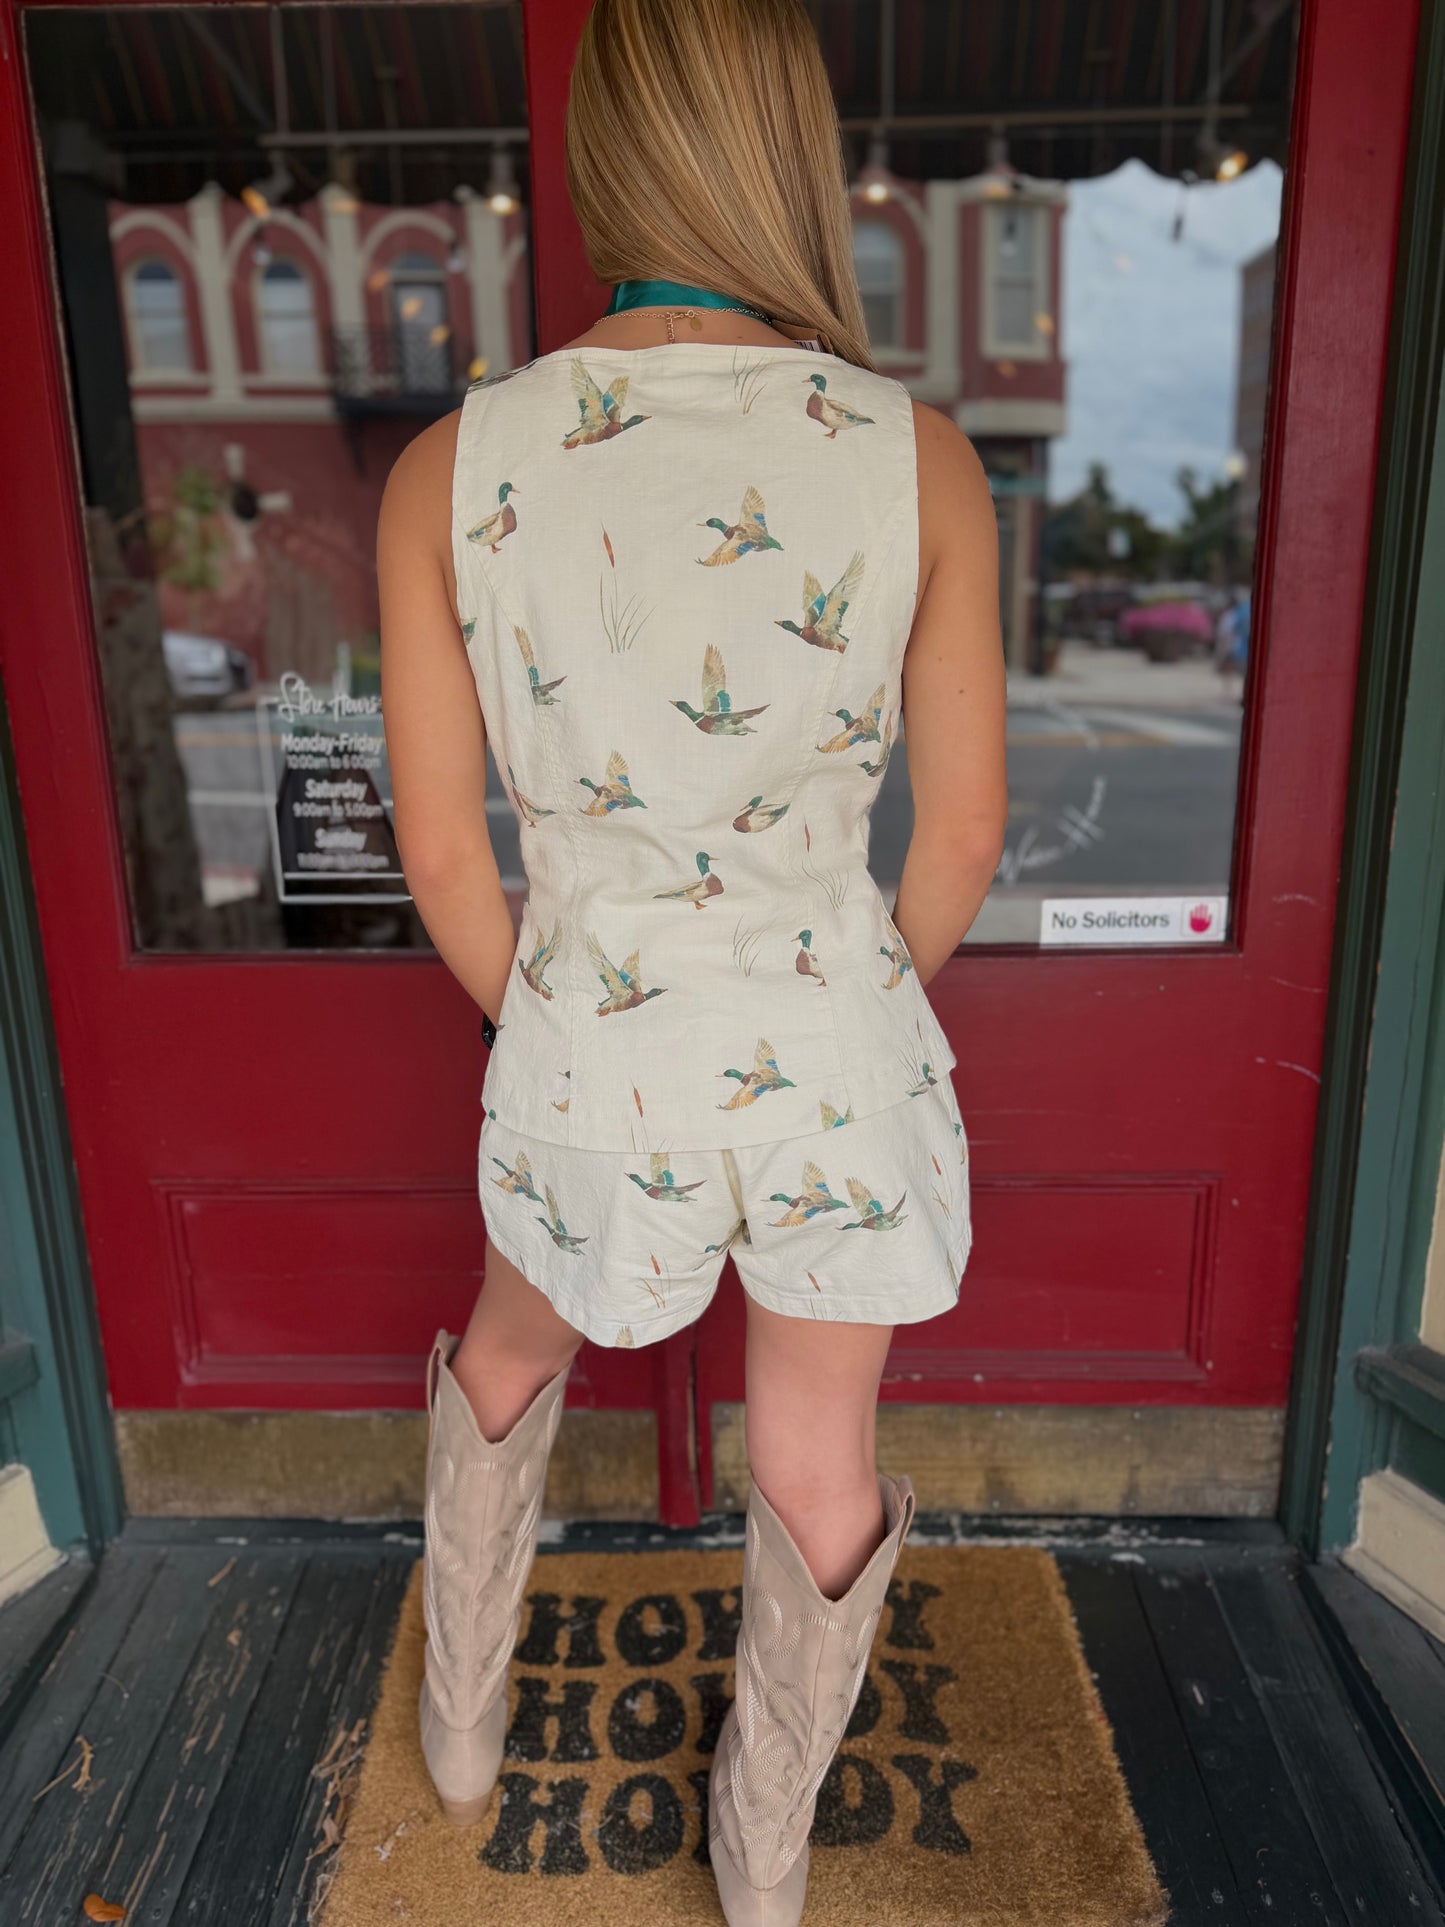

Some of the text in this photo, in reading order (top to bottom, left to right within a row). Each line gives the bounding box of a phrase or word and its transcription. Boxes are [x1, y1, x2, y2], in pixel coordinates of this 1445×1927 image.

[278, 672, 326, 723] Store
[281, 732, 382, 756] Monday-Friday
[305, 778, 368, 802] Saturday
[1052, 910, 1170, 929] No Solicitors
[477, 1754, 978, 1877] HODY
